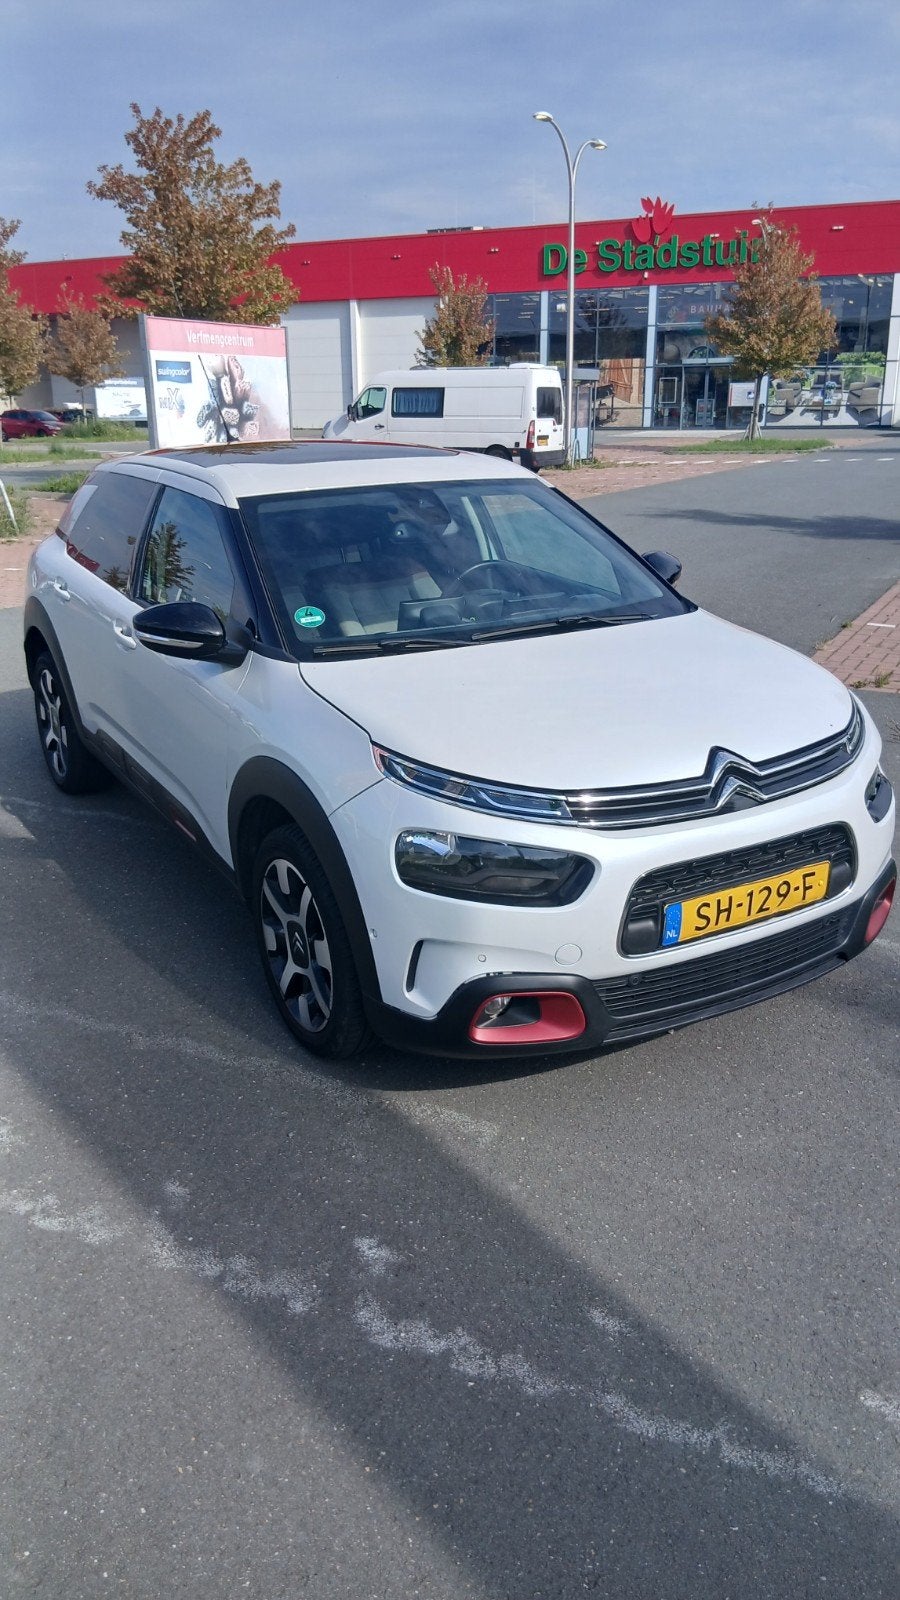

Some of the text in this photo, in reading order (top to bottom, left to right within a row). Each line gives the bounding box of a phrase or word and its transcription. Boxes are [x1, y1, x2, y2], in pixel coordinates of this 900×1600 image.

[543, 244, 588, 275] De
[690, 304, 748, 314] BAUHA
[187, 330, 254, 348] Verfmengcentrum
[304, 608, 313, 616] 4
[694, 871, 816, 931] SH-129-F
[666, 930, 678, 939] NL
